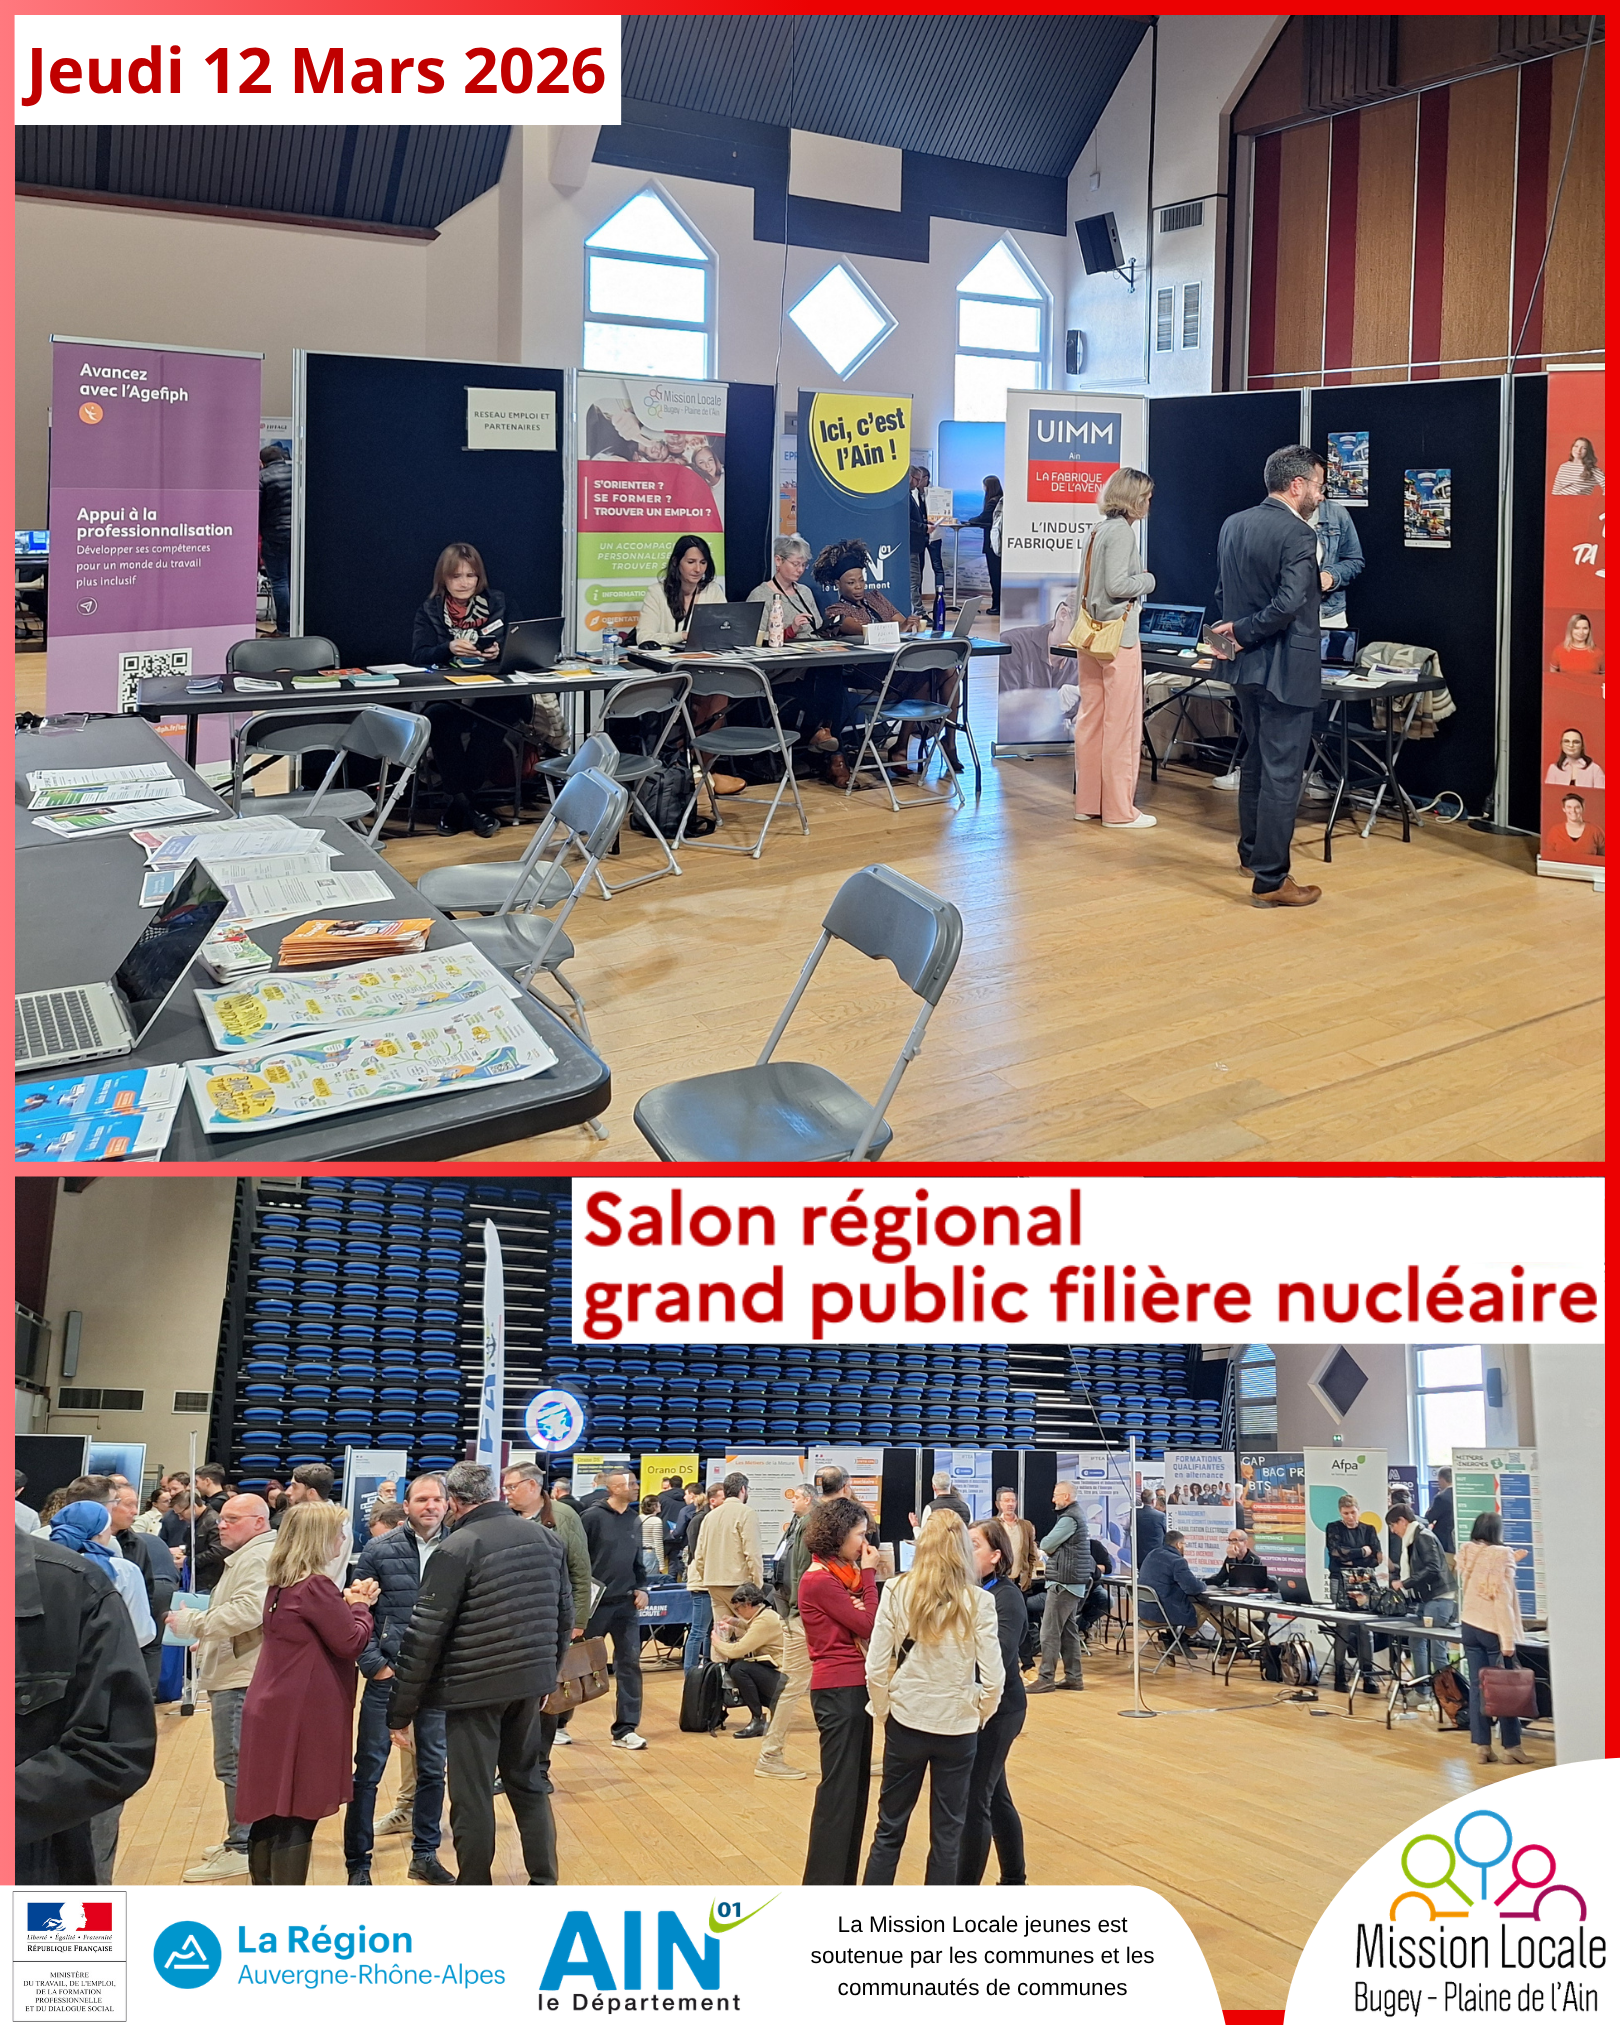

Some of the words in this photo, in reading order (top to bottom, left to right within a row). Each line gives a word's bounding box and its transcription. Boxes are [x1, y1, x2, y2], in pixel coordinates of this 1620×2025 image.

[80, 363, 147, 380] Avancez
[80, 385, 118, 397] avec
[122, 384, 189, 404] l'Agefiph
[664, 390, 695, 404] Mission
[698, 393, 721, 406] Locale
[474, 411, 506, 420] RESEAU
[508, 412, 539, 420] EMPLOI
[484, 423, 541, 431] PARTENAIRES
[819, 417, 852, 443] Ici,
[857, 408, 905, 435] c'est
[1037, 420, 1113, 445] UIMM
[837, 444, 884, 471] l'Ain
[889, 439, 897, 460] !
[1069, 452, 1080, 460] Ain
[1036, 472, 1049, 480] LA
[1052, 472, 1102, 483] FABRIQUE
[594, 480, 655, 490] S'ORIENTER
[659, 481, 664, 490] ?
[1051, 482, 1065, 492] DE
[594, 494, 608, 502] SE
[613, 494, 661, 503] FORMER
[666, 495, 672, 503] ?
[77, 508, 124, 524] Appui
[129, 507, 138, 521] à
[143, 507, 157, 521] la
[594, 507, 643, 516] TROUVER
[646, 508, 662, 516] UN
[664, 508, 703, 516] EMPLOI
[706, 508, 711, 516] ?
[77, 523, 232, 541] professionnalisation
[1032, 522, 1096, 533] L'INDUST
[76, 544, 133, 556] Développer
[135, 546, 149, 554] ses
[152, 543, 211, 555] compétences
[1008, 538, 1073, 551] FABRIQUE
[1572, 542, 1598, 566] TA
[76, 562, 101, 573] pour
[119, 560, 153, 569] monde
[155, 559, 168, 568] du
[171, 558, 201, 568] travail
[76, 577, 98, 589] plus
[100, 575, 136, 587] inclusif
[1241, 1456, 1265, 1466] CAP
[1331, 1459, 1358, 1472] Afpa
[1262, 1468, 1285, 1477] BAC
[1248, 1481, 1271, 1490] BTS
